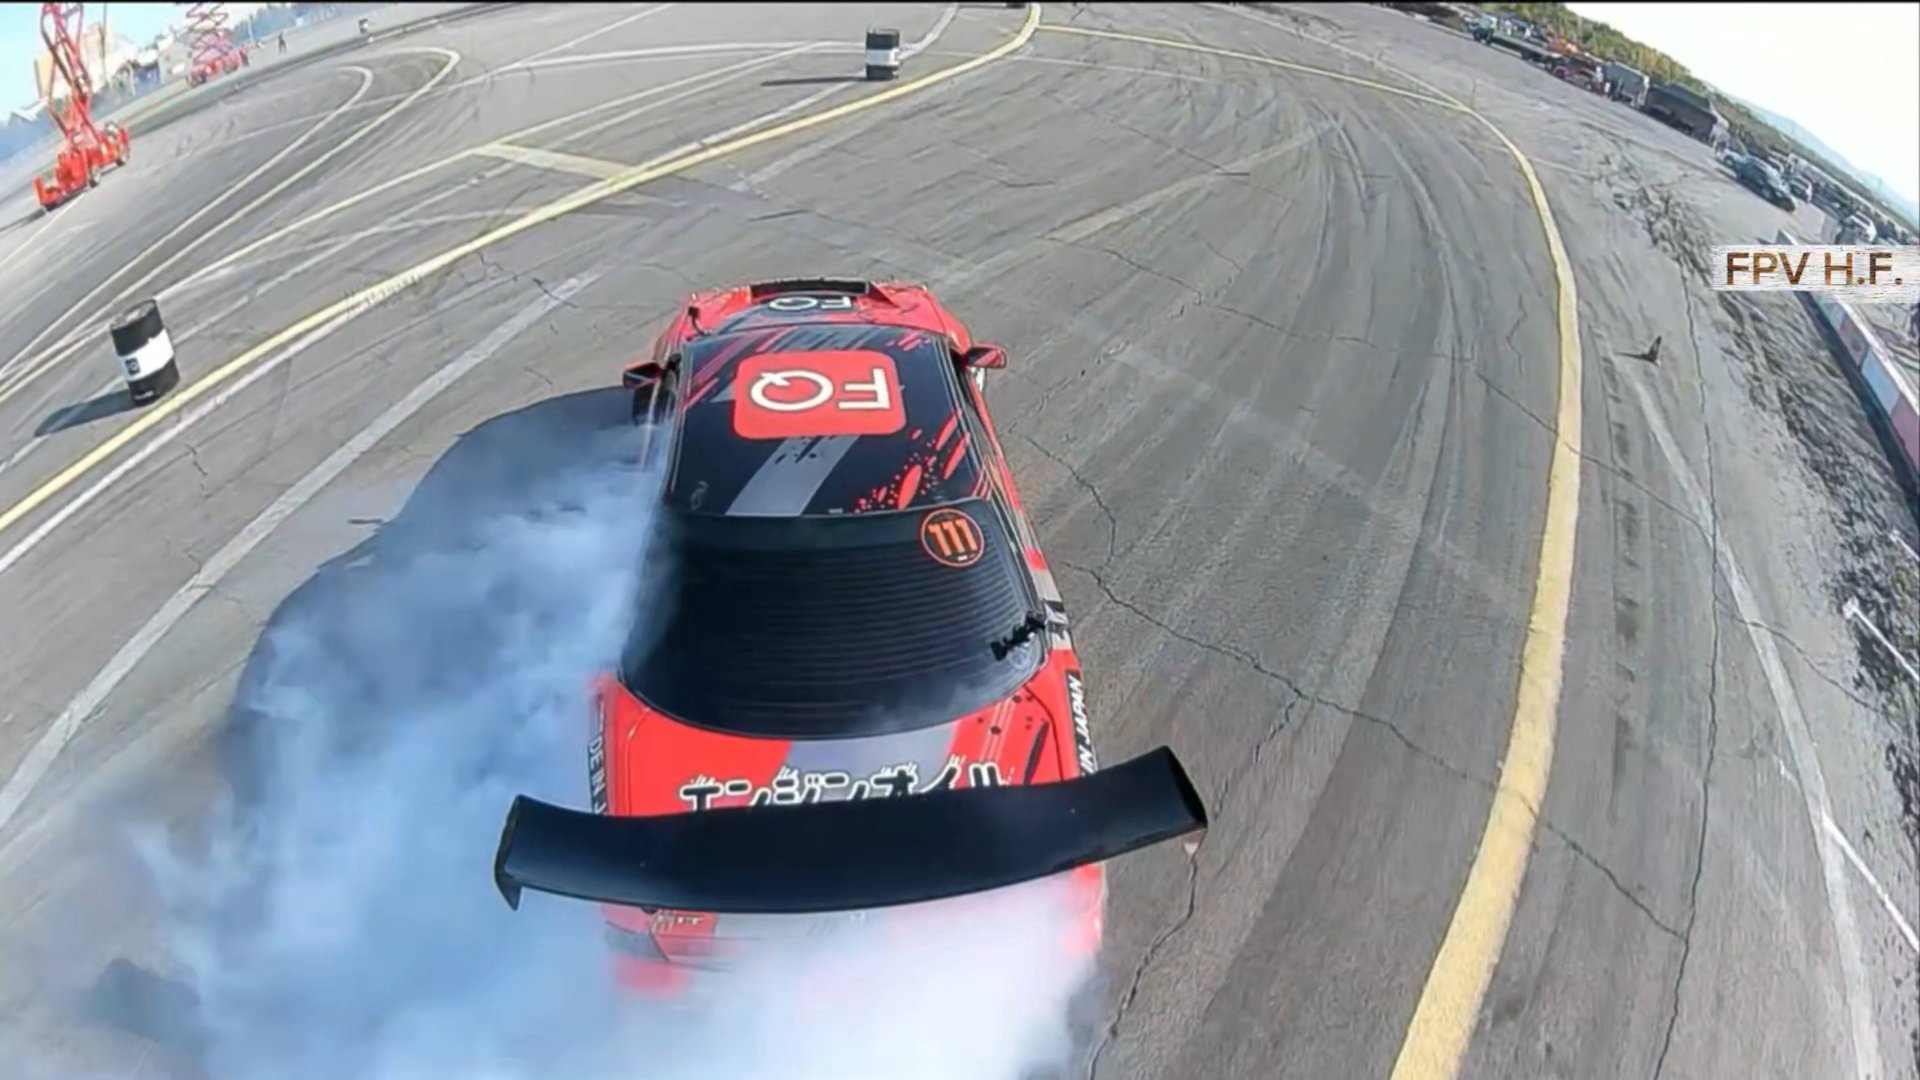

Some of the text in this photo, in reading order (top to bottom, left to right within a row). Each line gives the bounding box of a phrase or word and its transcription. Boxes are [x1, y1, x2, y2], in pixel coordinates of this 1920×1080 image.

[750, 368, 890, 411] FQ
[927, 517, 978, 557] 111
[1067, 673, 1091, 746] JAPAN
